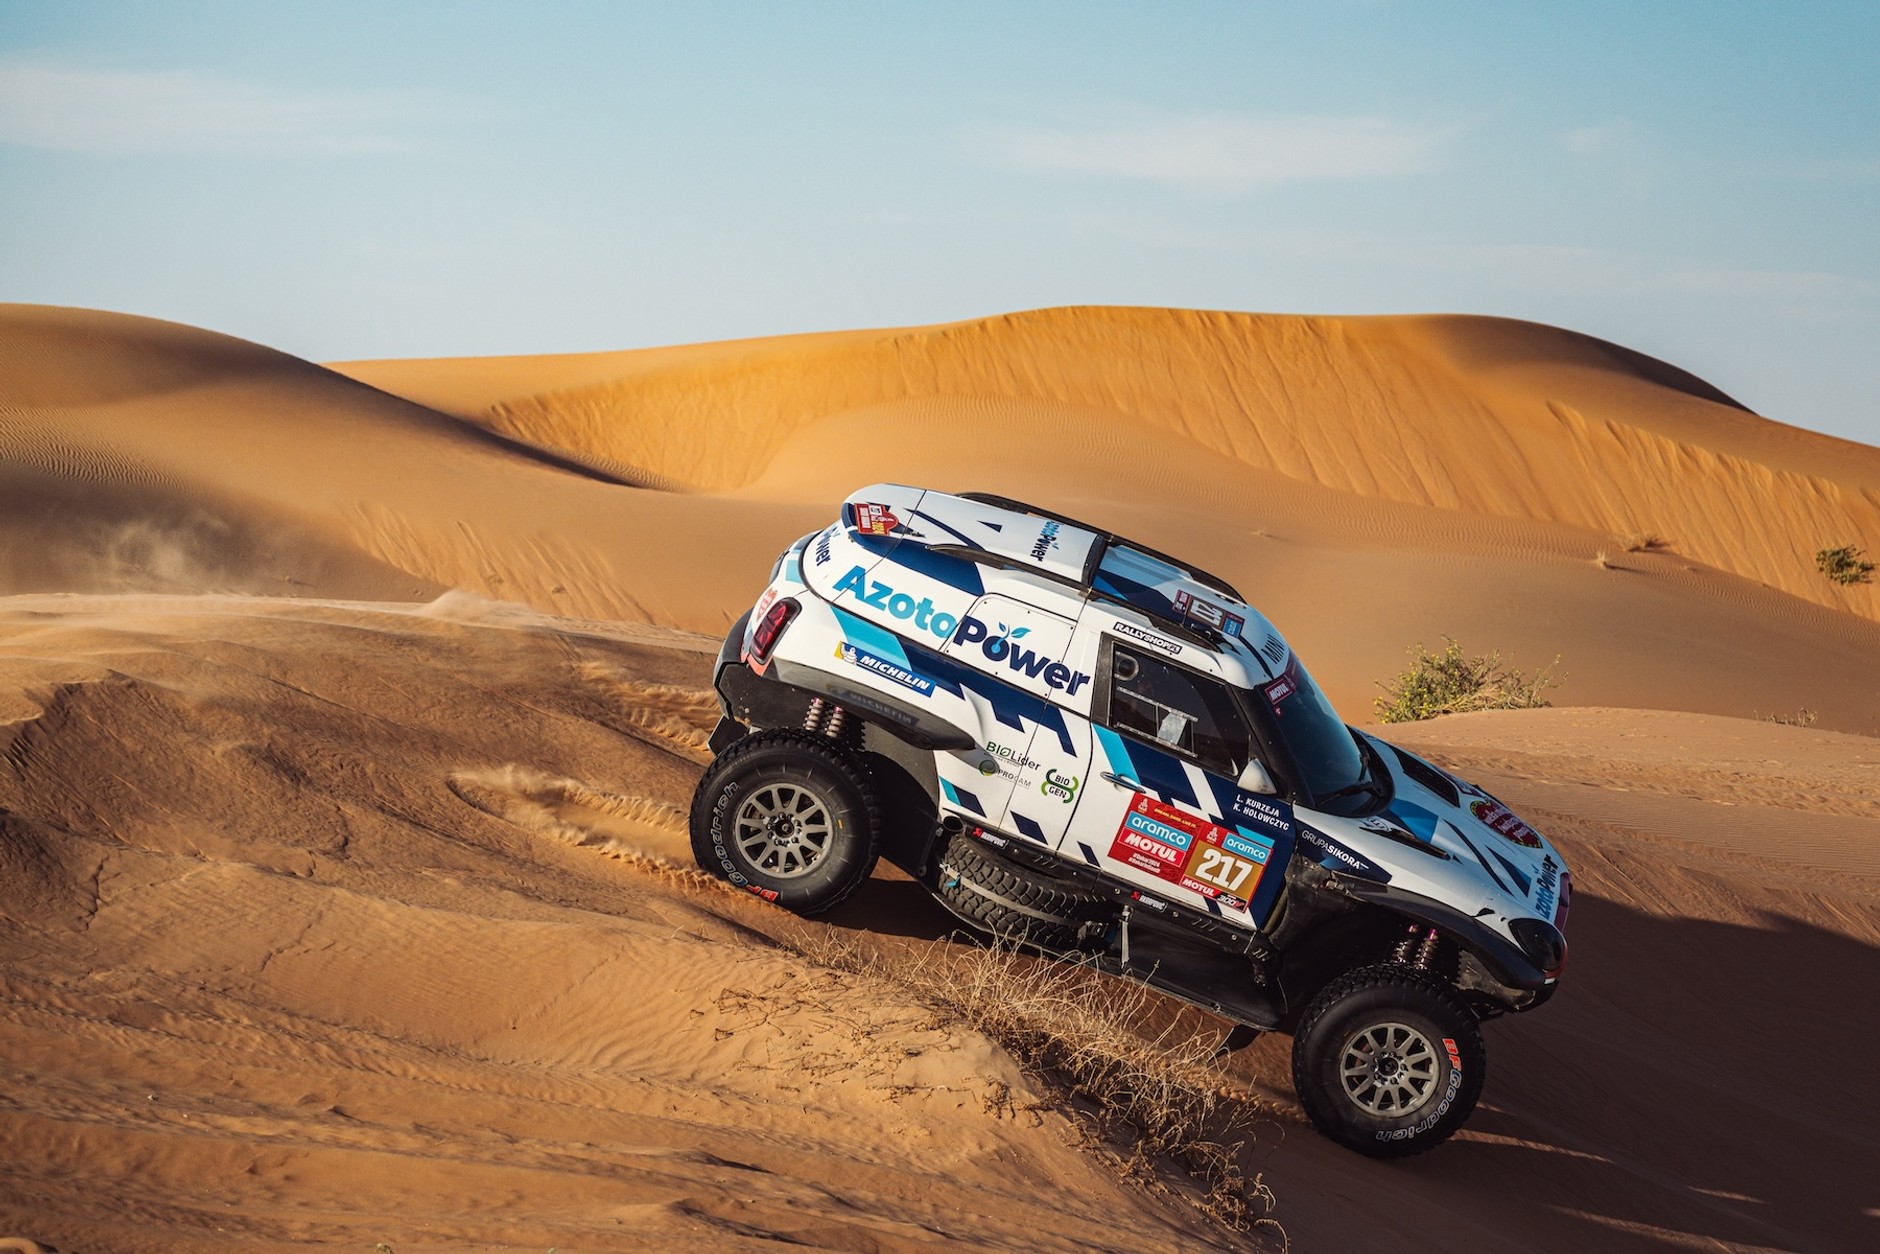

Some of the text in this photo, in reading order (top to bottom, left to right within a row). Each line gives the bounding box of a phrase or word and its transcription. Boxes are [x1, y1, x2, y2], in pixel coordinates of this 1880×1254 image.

[832, 565, 1091, 696] AzotoPower
[860, 655, 930, 690] MICHELIN
[1269, 682, 1289, 701] MOTUL
[1054, 774, 1070, 786] BIO
[1048, 786, 1067, 799] GEN
[1233, 803, 1241, 812] K.
[1245, 798, 1280, 817] KURZEJA
[1131, 817, 1187, 846] aramco
[1124, 832, 1178, 862] MOTUL
[1226, 838, 1266, 860] aramco
[1194, 848, 1253, 892] 217
[1182, 878, 1215, 897] MOTUL
